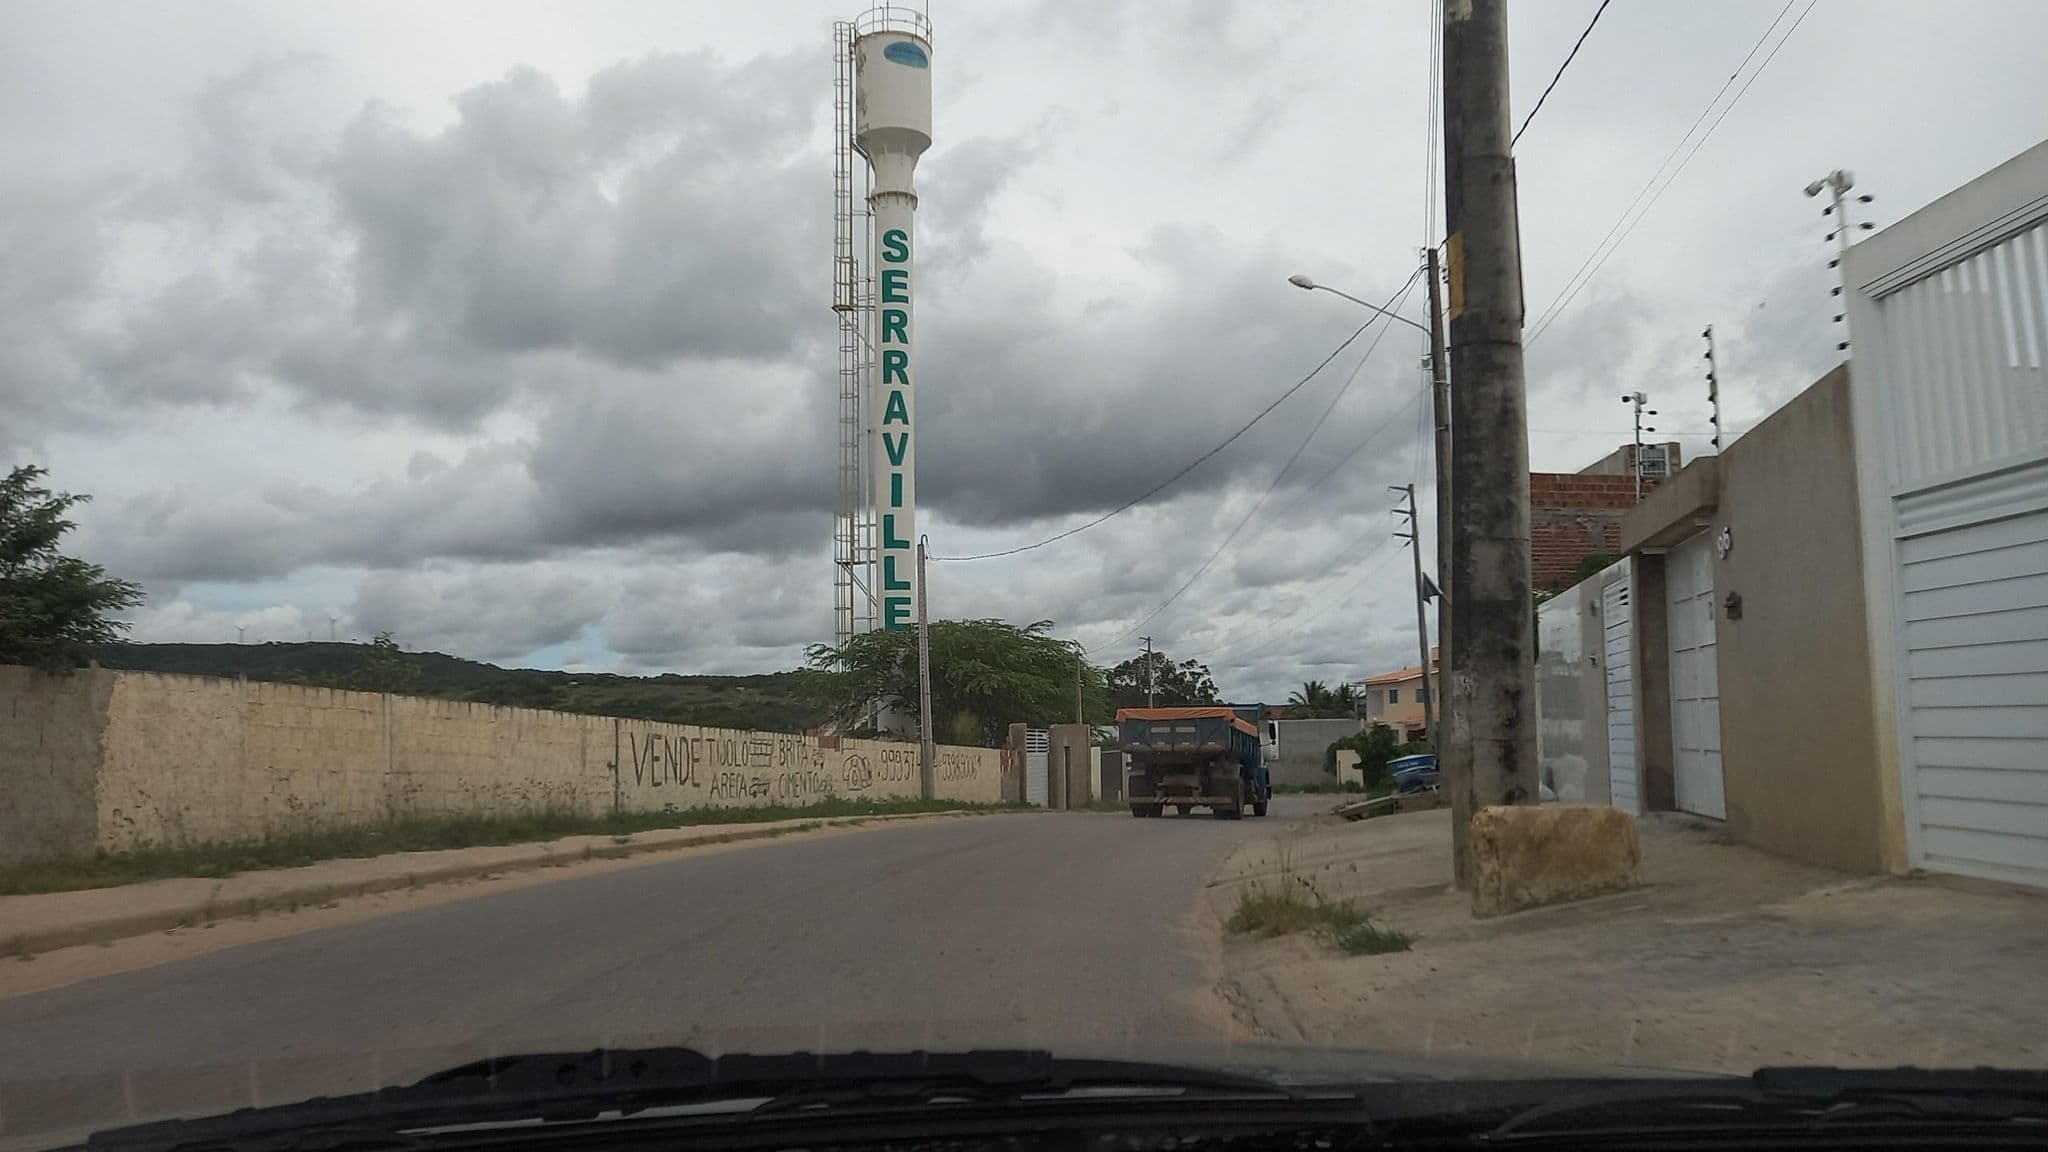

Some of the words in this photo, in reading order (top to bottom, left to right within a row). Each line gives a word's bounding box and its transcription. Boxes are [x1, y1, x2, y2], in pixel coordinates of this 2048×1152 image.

[881, 228, 912, 630] SERRAVILLE
[630, 732, 701, 788] VENDE
[705, 738, 749, 767] TIJOLO
[710, 773, 748, 800] AREIA
